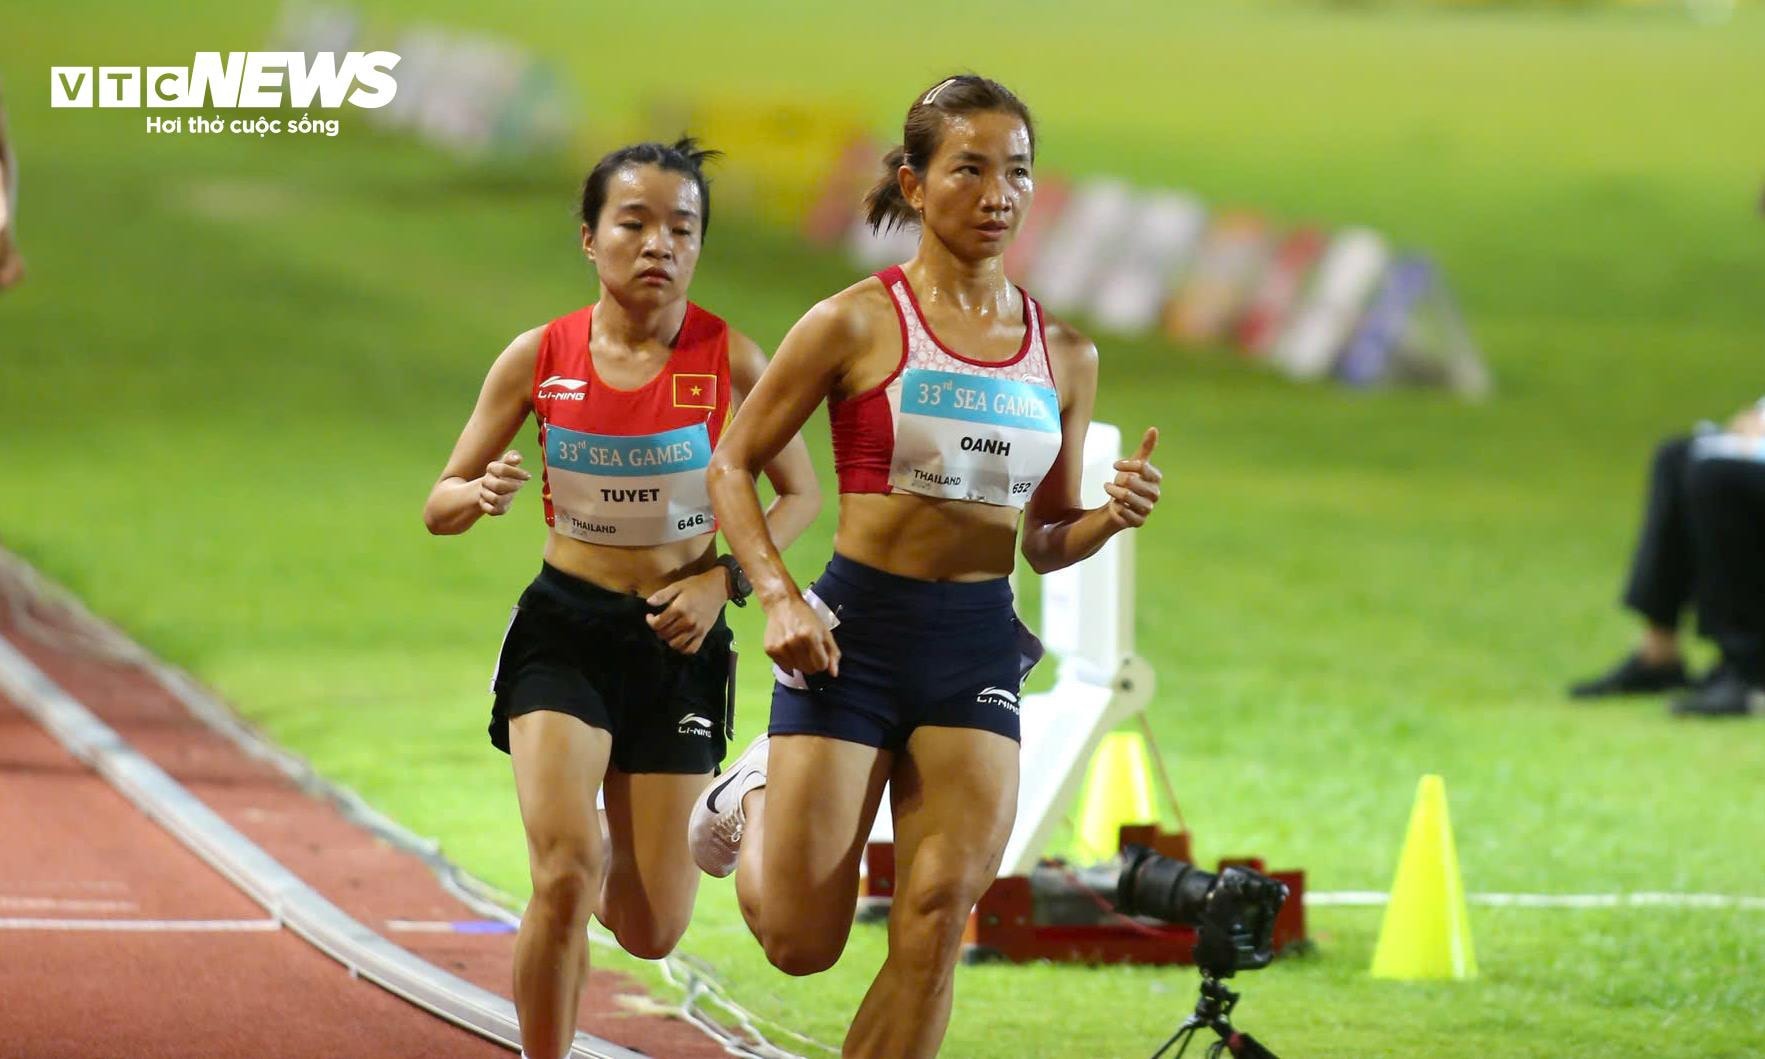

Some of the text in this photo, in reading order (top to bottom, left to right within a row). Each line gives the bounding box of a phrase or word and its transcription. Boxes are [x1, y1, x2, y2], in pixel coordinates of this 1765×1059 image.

[538, 391, 586, 400] LI-NING
[954, 388, 988, 411] SEA
[589, 447, 623, 466] SEA
[629, 441, 693, 465] GAMES
[960, 436, 1011, 456] OANH
[913, 469, 961, 486] THAILAND
[601, 488, 660, 502] TUYET
[1012, 482, 1031, 494] 652
[571, 518, 616, 534] THAILAND
[677, 514, 704, 531] 646
